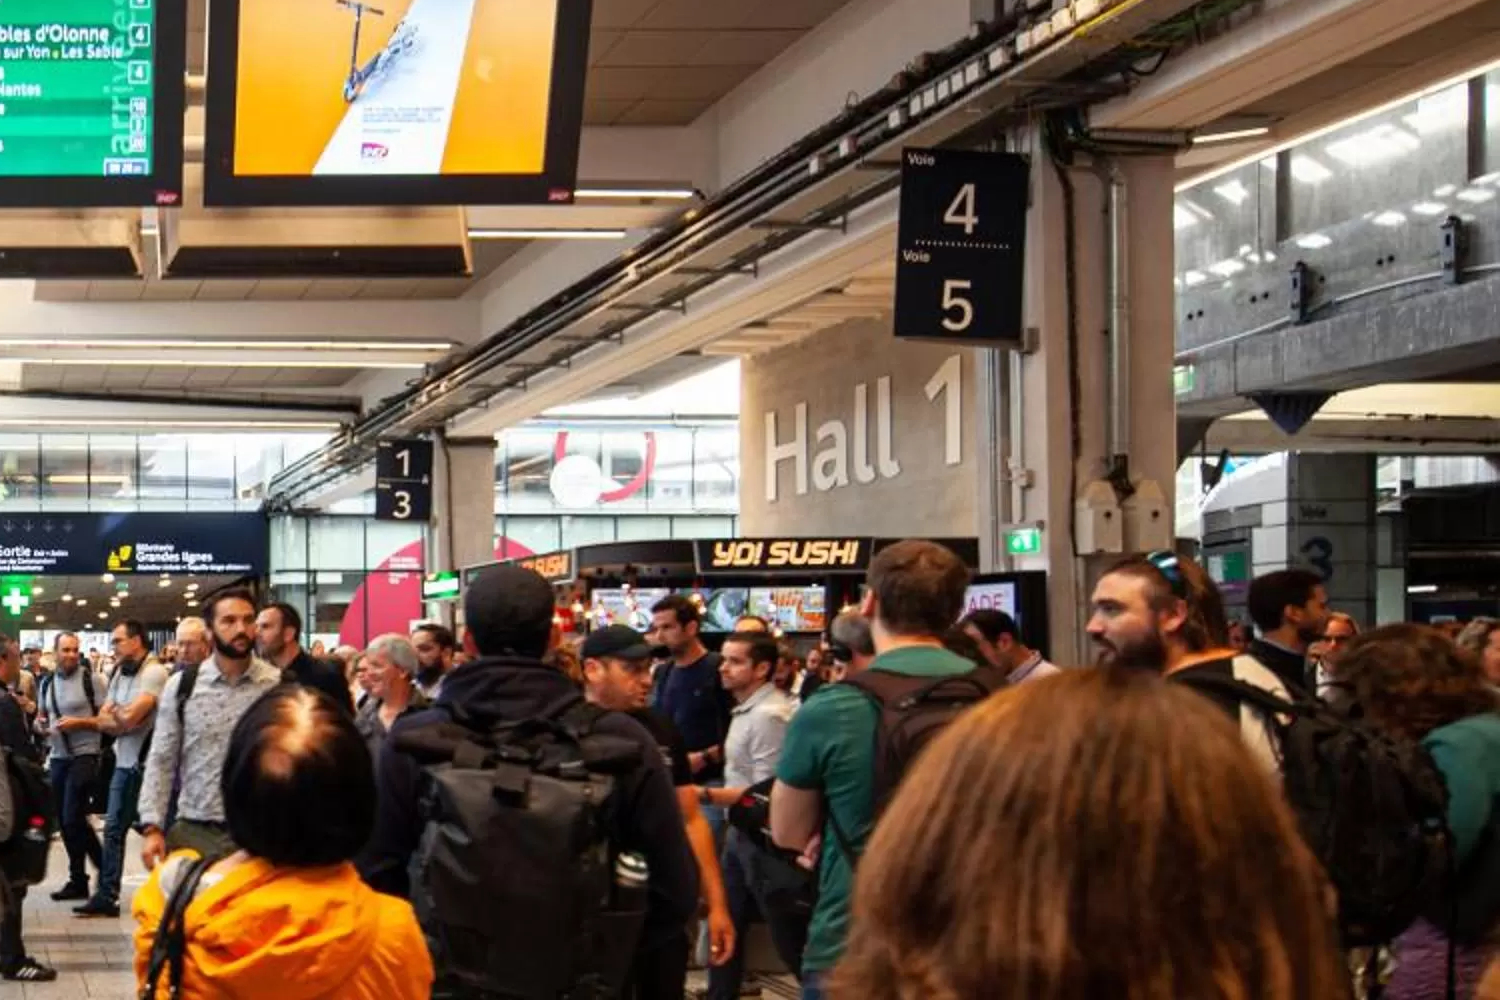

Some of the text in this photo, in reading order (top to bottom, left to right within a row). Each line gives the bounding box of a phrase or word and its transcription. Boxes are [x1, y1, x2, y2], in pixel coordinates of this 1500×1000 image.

[35, 24, 110, 43] d'Olonne
[3, 48, 24, 59] sur
[26, 46, 51, 59] Yon
[61, 45, 84, 59] Les
[907, 152, 935, 167] Voie
[943, 183, 979, 235] 4
[903, 250, 931, 264] Voie
[941, 279, 974, 332] 5
[764, 353, 962, 502] Hall 1
[395, 449, 411, 477] 1
[392, 490, 412, 519] 3
[136, 551, 213, 565] Grandes lignes
[712, 540, 859, 567] YO! SUSHI
